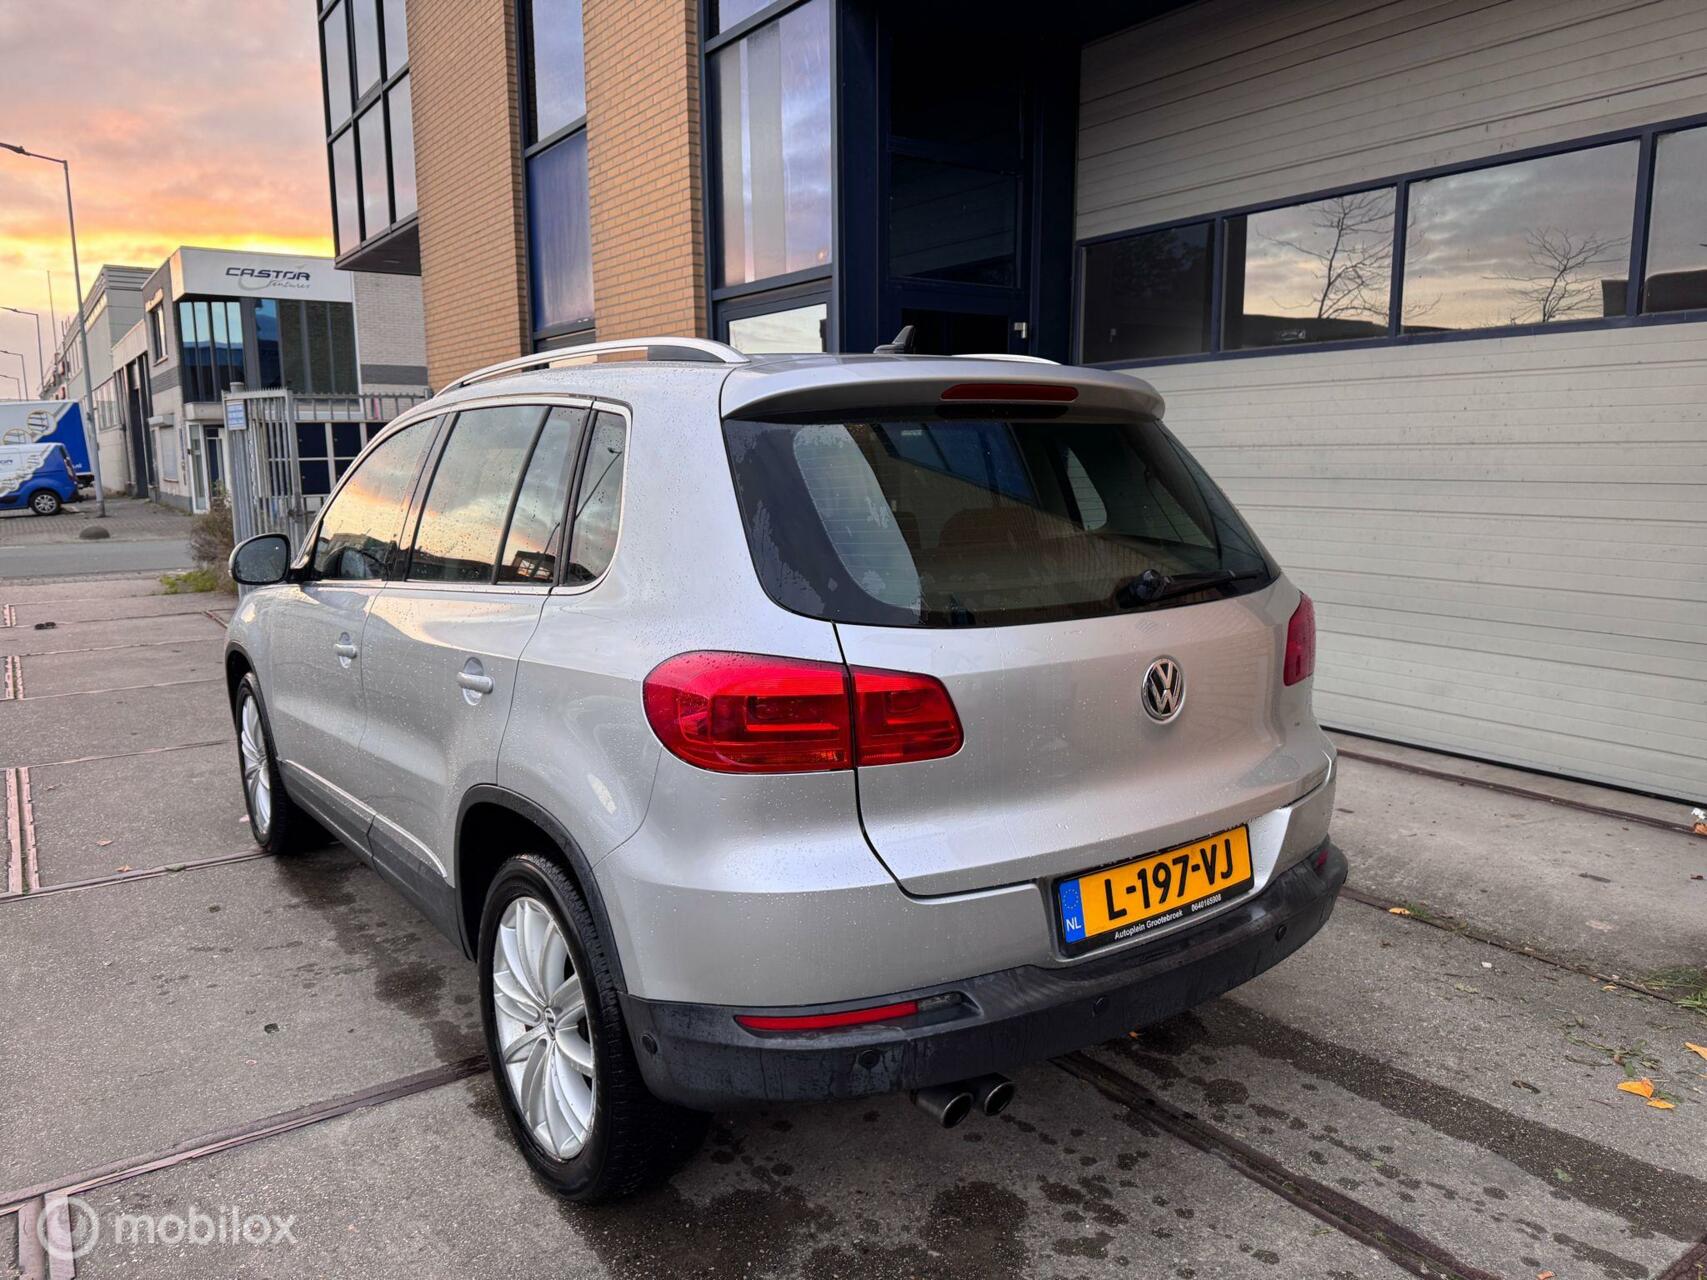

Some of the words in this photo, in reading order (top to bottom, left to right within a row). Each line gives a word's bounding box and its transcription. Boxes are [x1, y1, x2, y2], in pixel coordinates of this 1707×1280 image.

[225, 267, 311, 281] CASTOR
[1104, 839, 1233, 920] L-197-VJ
[1066, 918, 1081, 932] NL
[1114, 922, 1145, 940] Autoplein
[1146, 909, 1184, 929] Grootebroek
